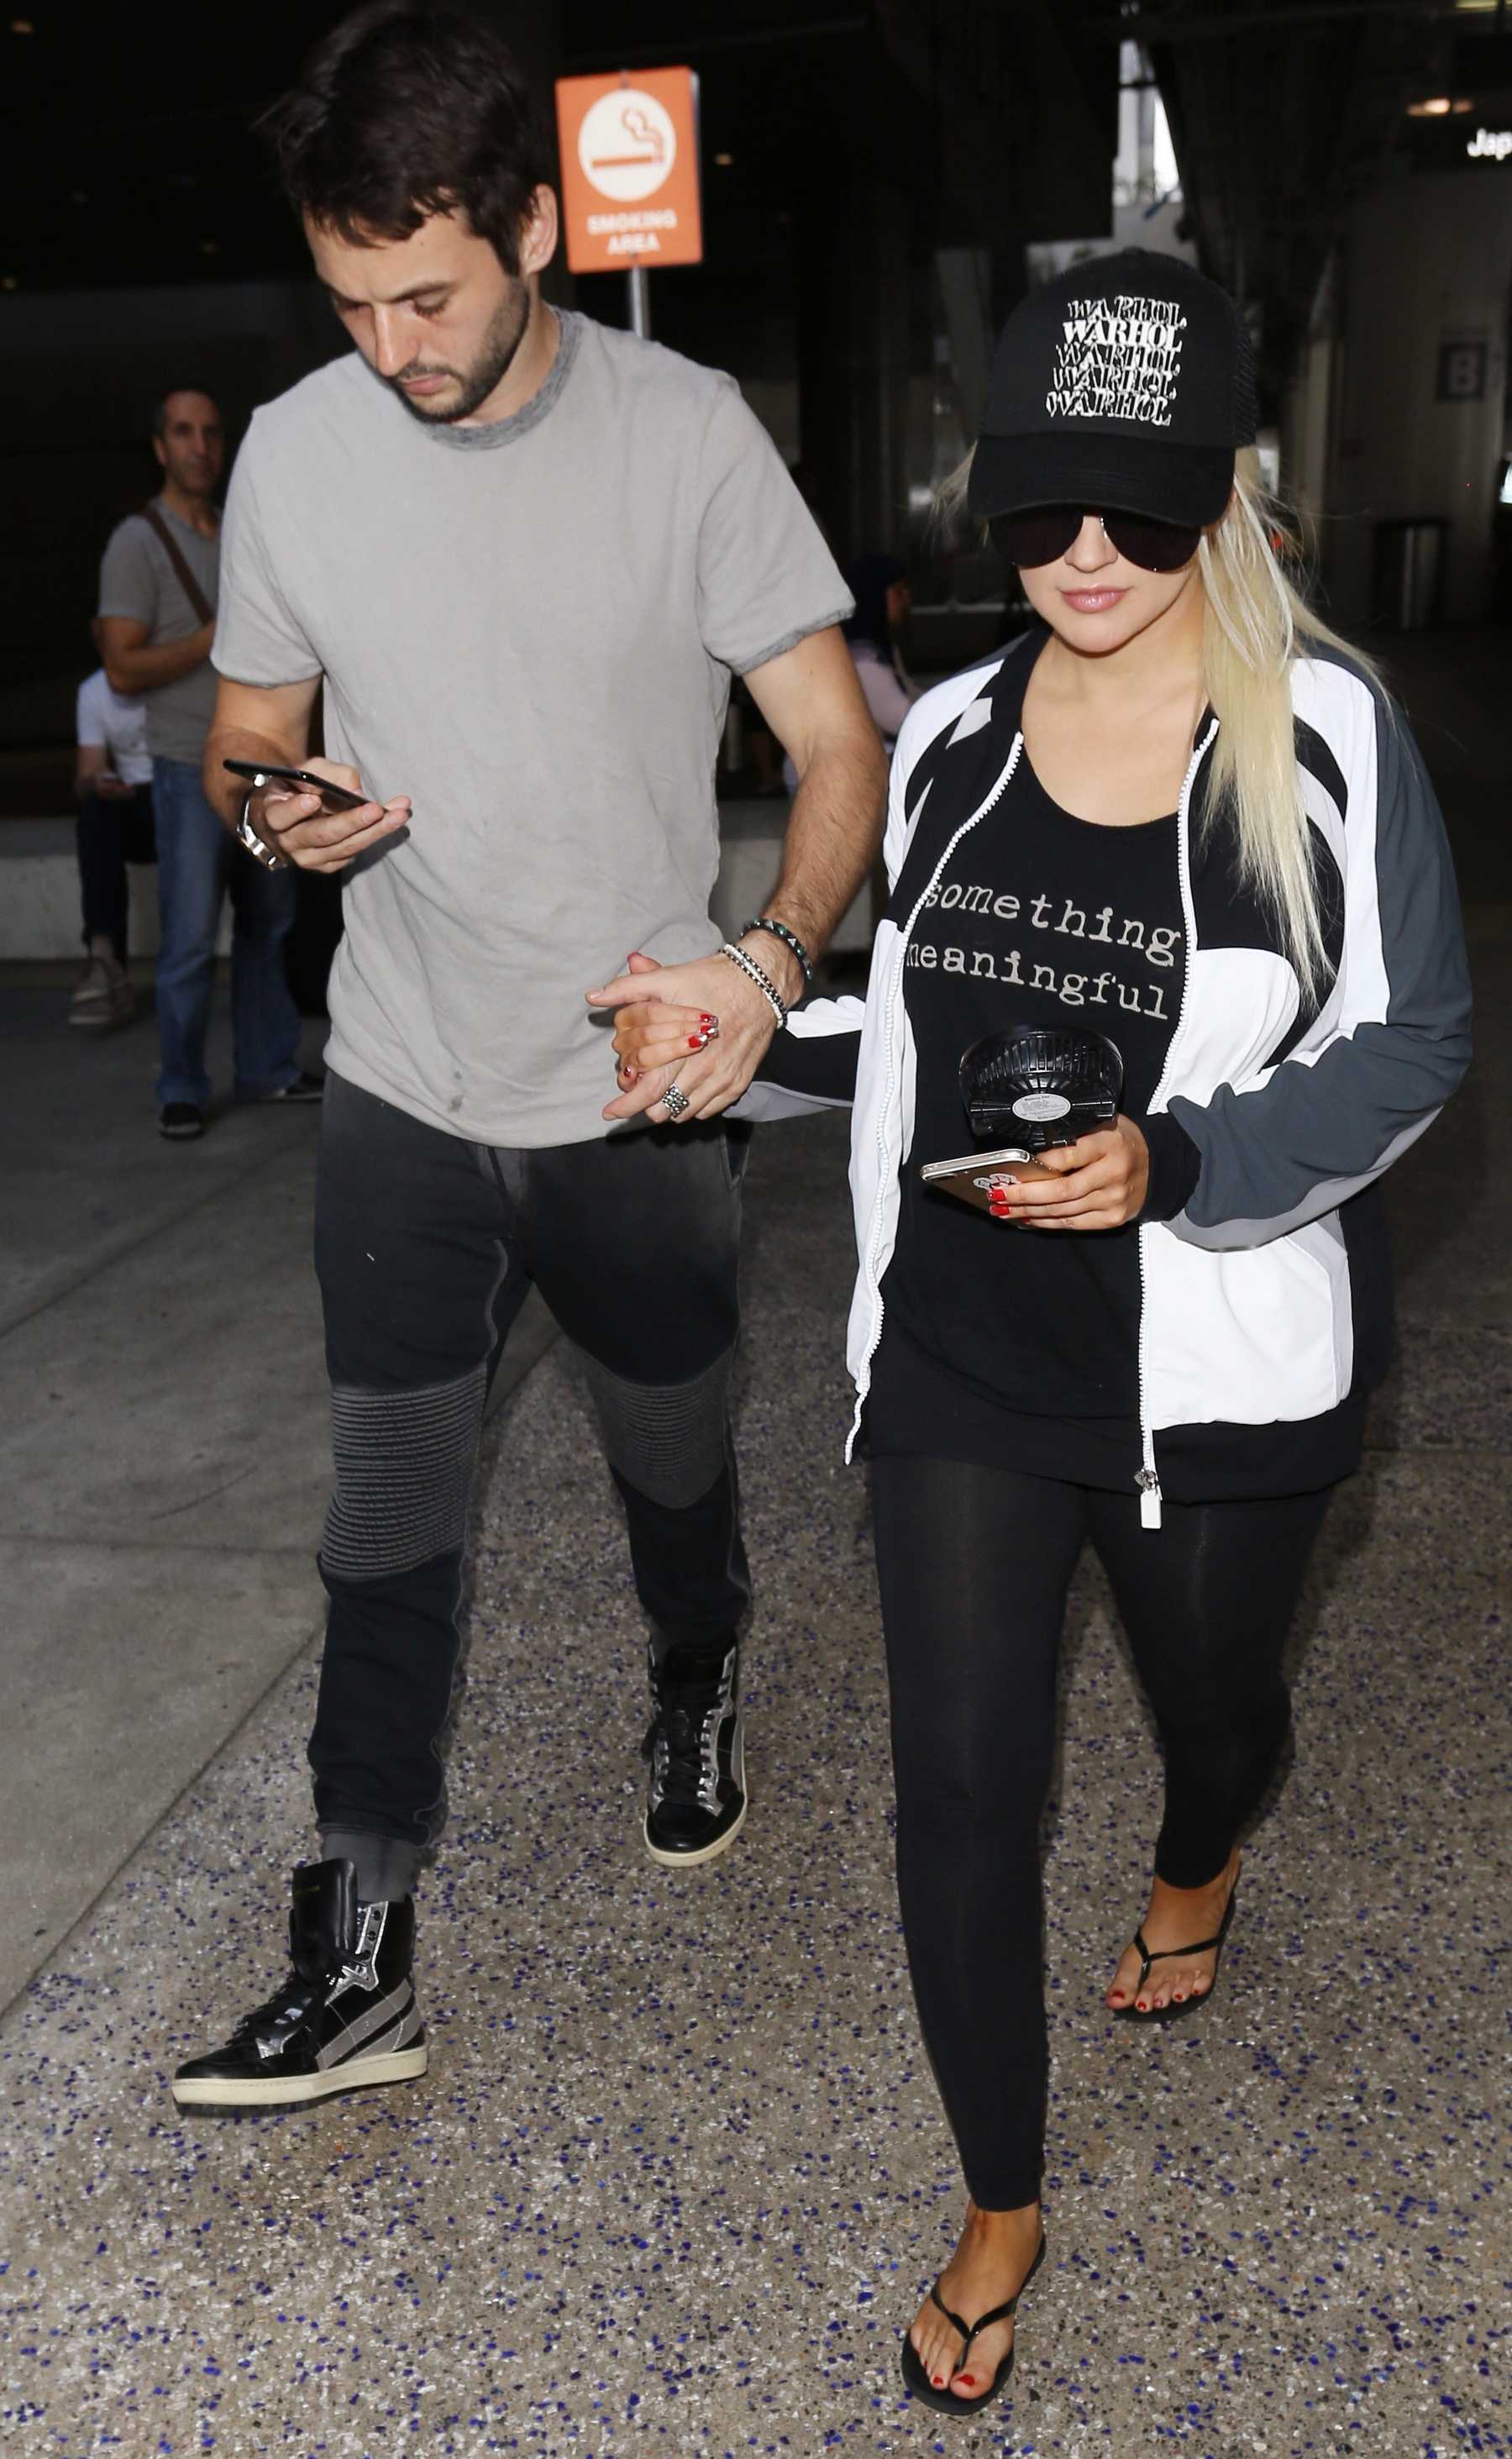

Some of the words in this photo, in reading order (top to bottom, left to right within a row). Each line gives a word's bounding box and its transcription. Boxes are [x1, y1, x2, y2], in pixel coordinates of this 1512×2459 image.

[586, 208, 678, 235] SMOKING
[606, 234, 660, 255] AREA
[1068, 296, 1187, 328] WARHOL
[1063, 318, 1182, 352] WARHOL
[1056, 341, 1180, 376] WARHOL
[1053, 366, 1177, 400] WARHOL
[1046, 387, 1172, 426] WARHOL
[925, 883, 1182, 967] something
[906, 942, 1168, 1020] meaningful
